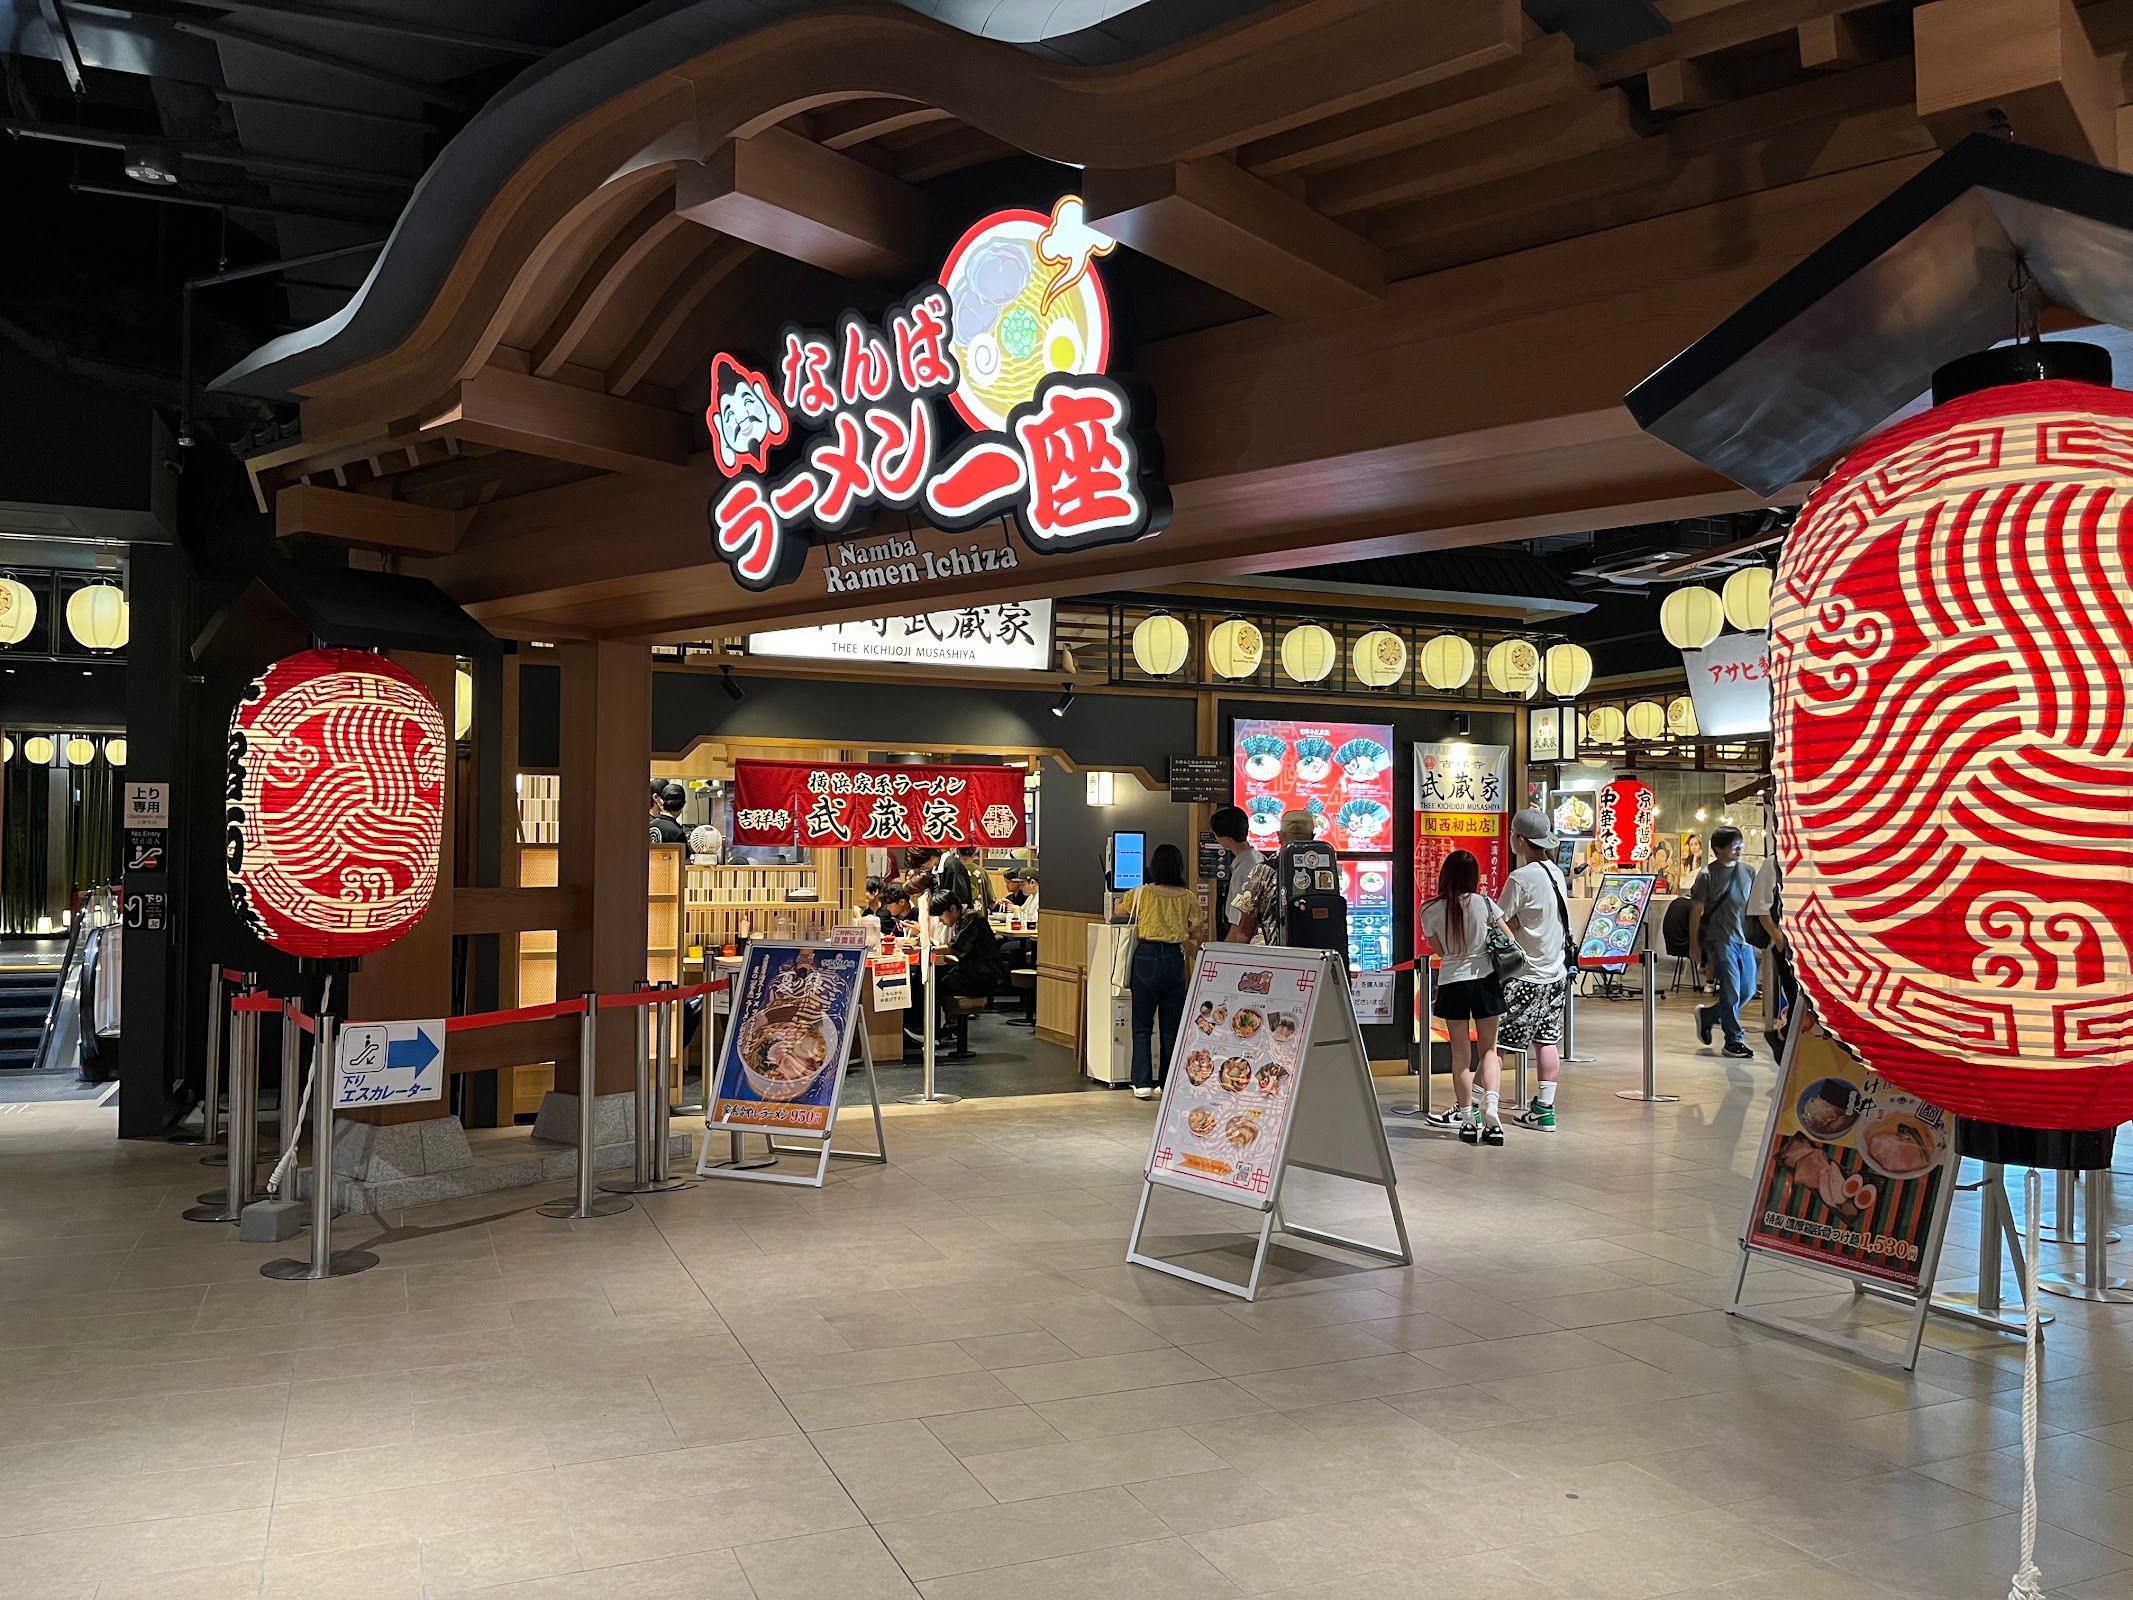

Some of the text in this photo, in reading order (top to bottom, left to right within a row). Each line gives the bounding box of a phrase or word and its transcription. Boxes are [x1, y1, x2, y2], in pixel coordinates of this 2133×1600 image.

[782, 294, 958, 418] なんば
[714, 384, 1140, 581] ラーメン一座
[838, 537, 918, 568] Namba
[823, 544, 1019, 593] Ramen Ichiza
[832, 642, 976, 660] THEE KICHIJOJI MUSASHIYA
[131, 787, 160, 800] 上り
[808, 770, 966, 795] 横浜家系ラーメン
[1421, 770, 1499, 802] 武蔵家
[133, 801, 160, 813] 専用
[737, 808, 791, 832] 吉祥寺
[805, 796, 966, 843] 武蔵家
[1600, 787, 1620, 860] 中華そば
[1634, 788, 1653, 860] 京都醤油
[340, 1083, 432, 1102] エスカレーター
[343, 1075, 366, 1089] 下り
